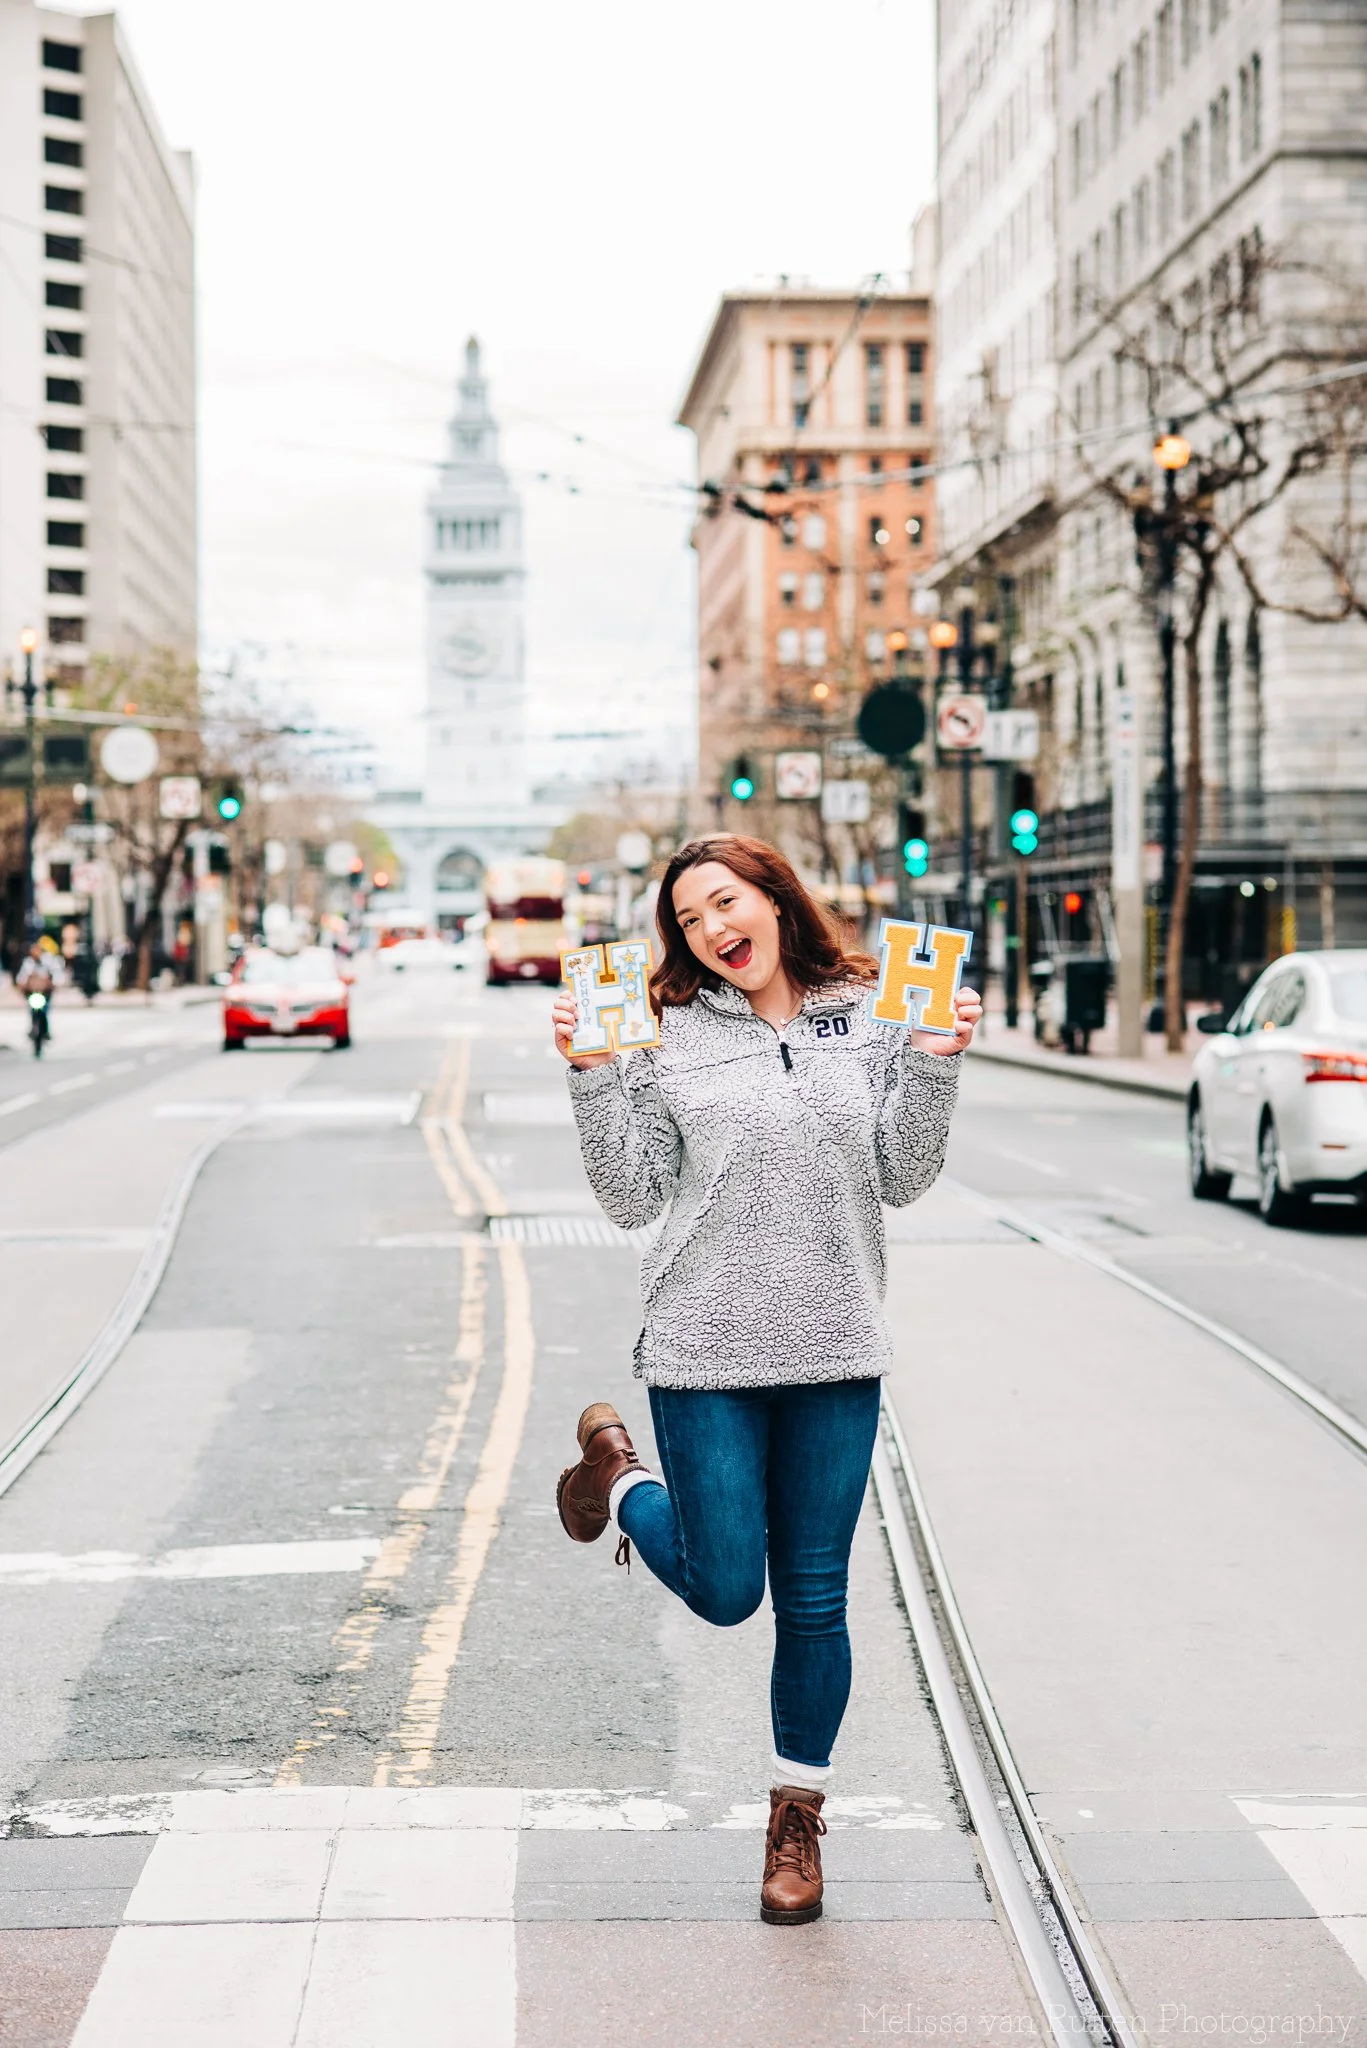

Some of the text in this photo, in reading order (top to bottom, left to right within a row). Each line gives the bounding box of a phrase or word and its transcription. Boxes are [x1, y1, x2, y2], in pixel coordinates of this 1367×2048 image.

[868, 918, 974, 1036] H
[580, 978, 591, 1025] CHOIR
[815, 1017, 849, 1038] 20
